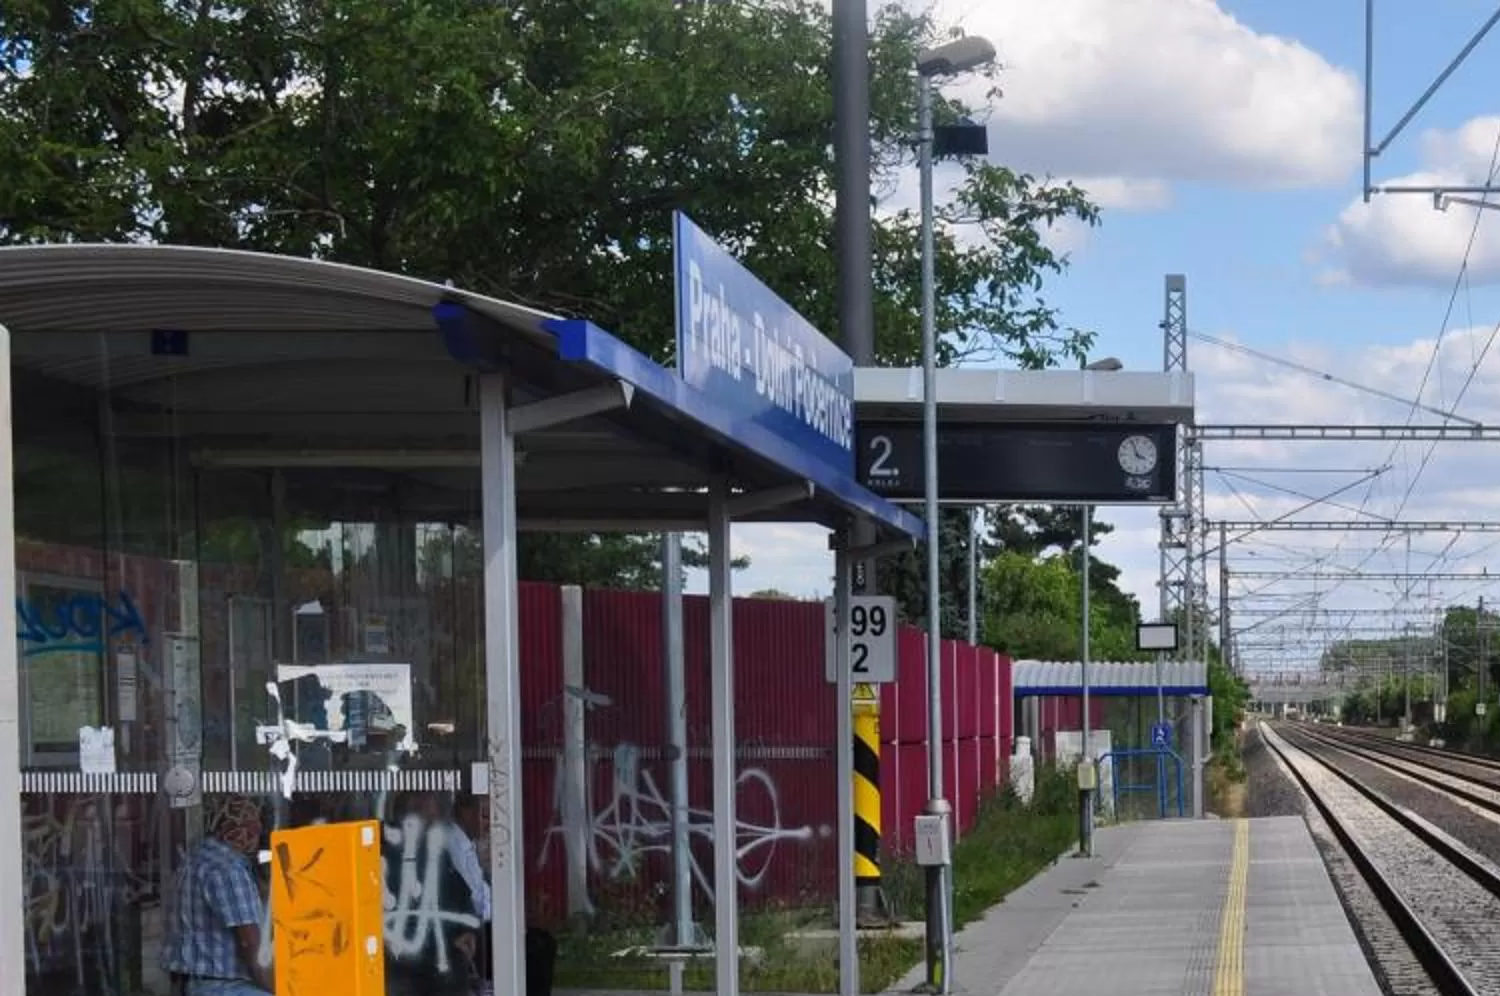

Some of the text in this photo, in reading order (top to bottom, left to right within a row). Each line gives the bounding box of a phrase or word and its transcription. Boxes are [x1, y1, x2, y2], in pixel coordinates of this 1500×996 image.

[689, 259, 741, 382] Praha
[754, 310, 793, 414] Dolní
[870, 435, 900, 476] 2.
[832, 605, 887, 636] 99
[851, 643, 869, 673] 2
